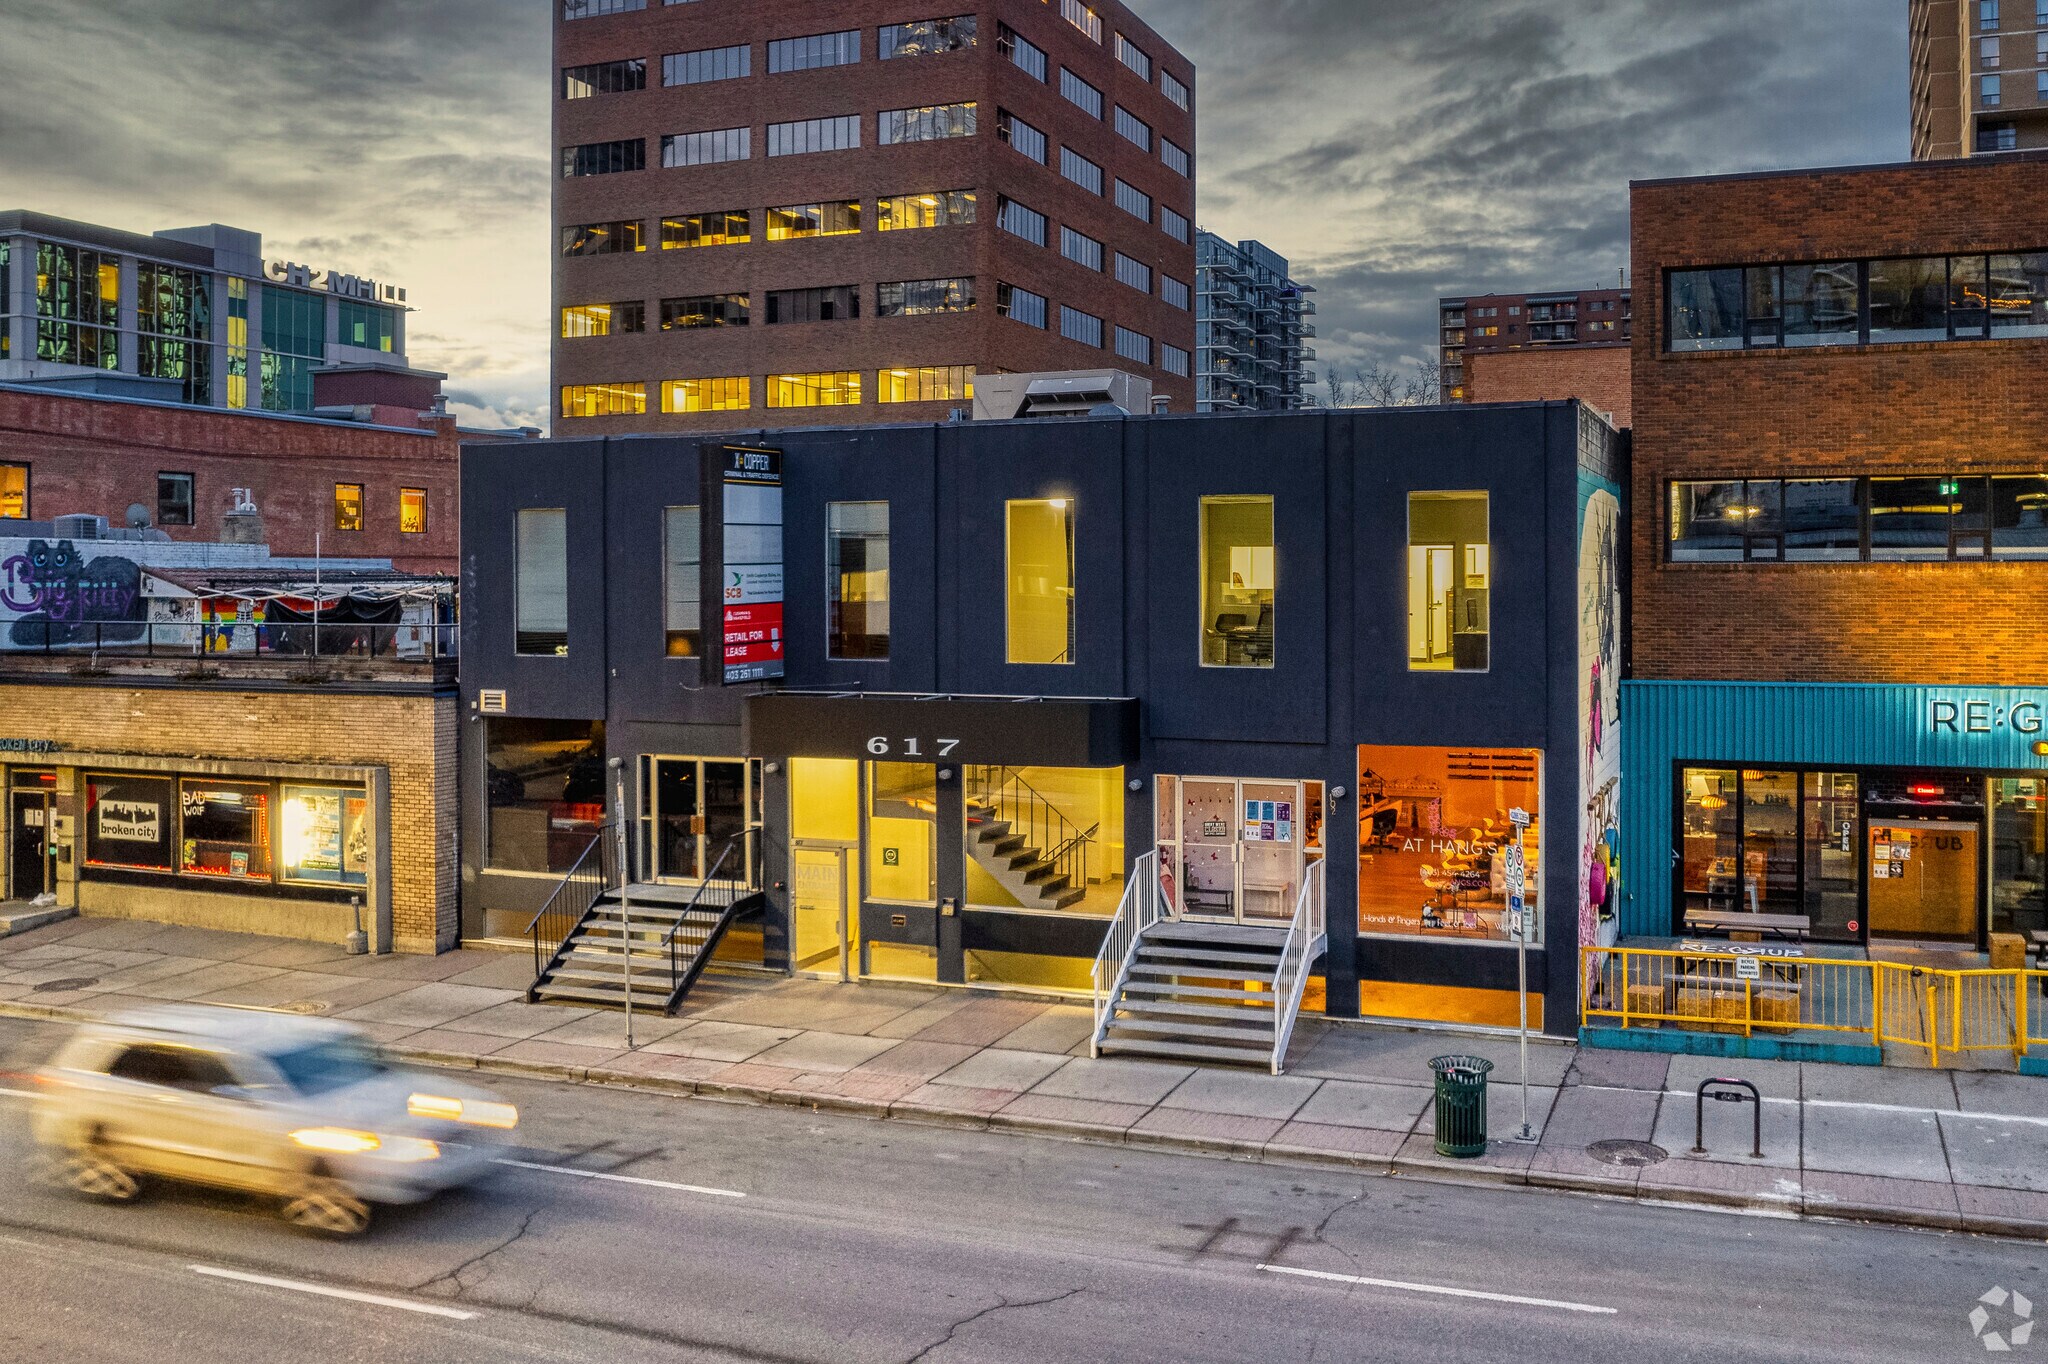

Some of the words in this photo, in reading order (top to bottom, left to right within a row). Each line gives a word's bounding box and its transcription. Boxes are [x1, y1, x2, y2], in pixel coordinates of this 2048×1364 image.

[724, 587, 742, 599] SCB
[725, 632, 748, 643] RETAIL
[749, 630, 763, 640] FOR
[725, 646, 748, 657] LEASE
[725, 670, 739, 680] 403
[740, 669, 751, 679] 261
[866, 736, 960, 756] 617
[182, 791, 206, 806] BAD
[183, 806, 205, 817] WOLF
[101, 822, 136, 836] broken
[137, 825, 157, 840] city
[1842, 822, 1851, 852] OPEN
[1403, 838, 1424, 853] AT
[797, 865, 839, 881] MAIN
[1363, 913, 1386, 923] Hands
